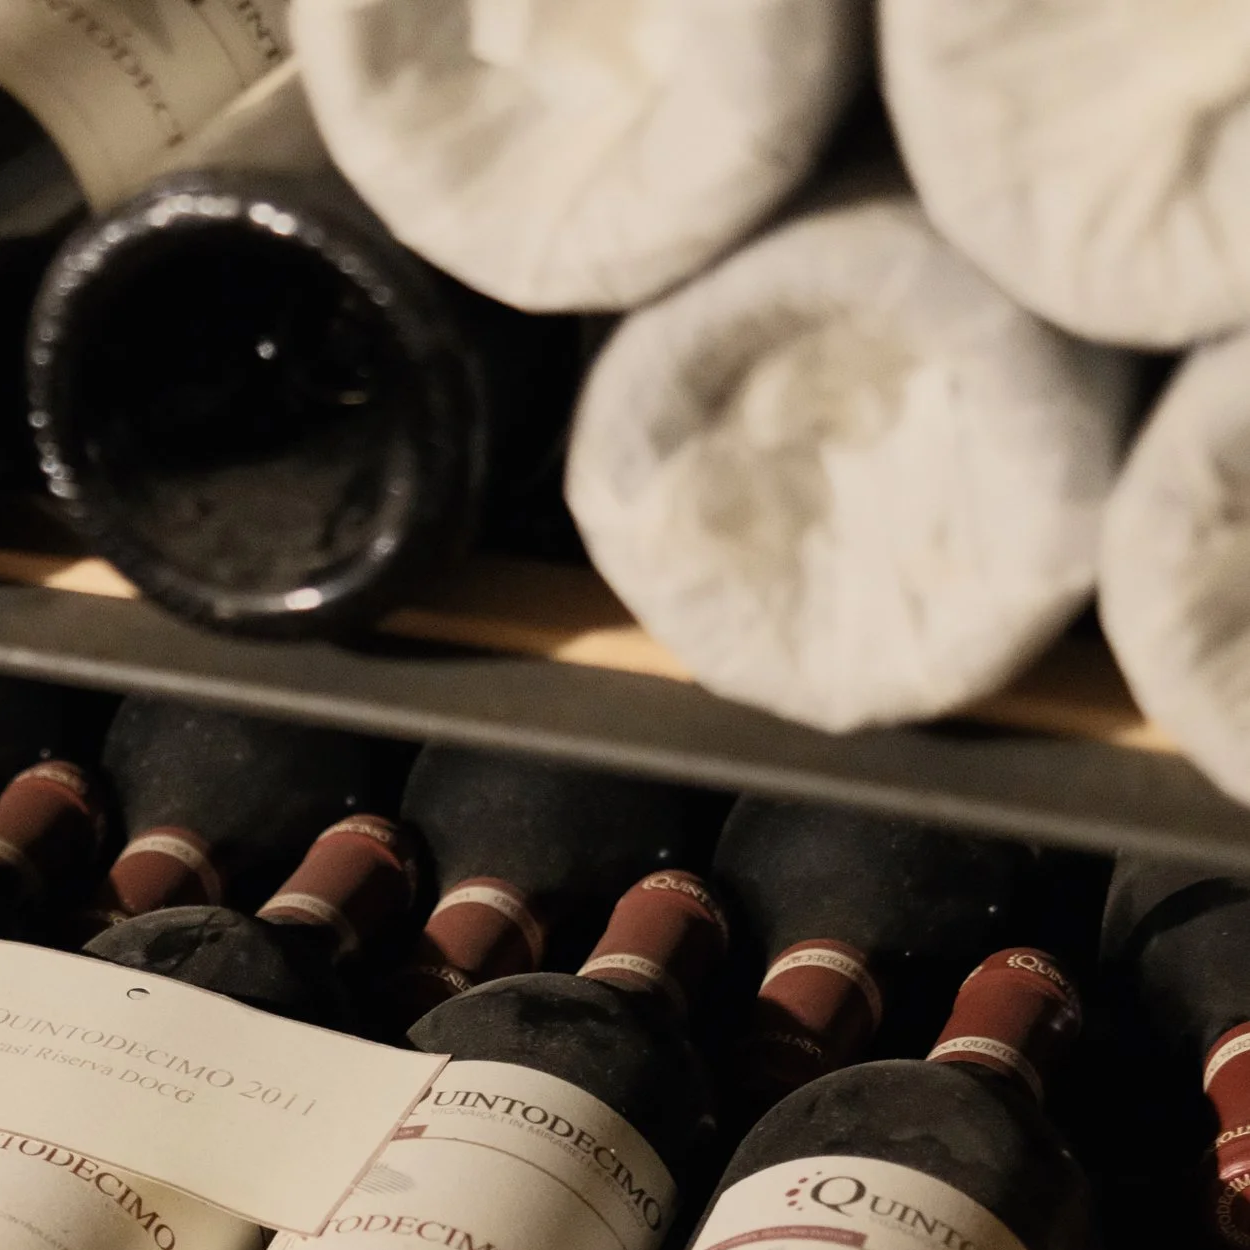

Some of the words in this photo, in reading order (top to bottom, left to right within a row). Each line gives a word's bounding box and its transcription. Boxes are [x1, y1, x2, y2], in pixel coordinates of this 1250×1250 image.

[34, 1045, 113, 1077] Riserva
[117, 1067, 199, 1105] DOCG
[237, 1079, 317, 1117] 2011
